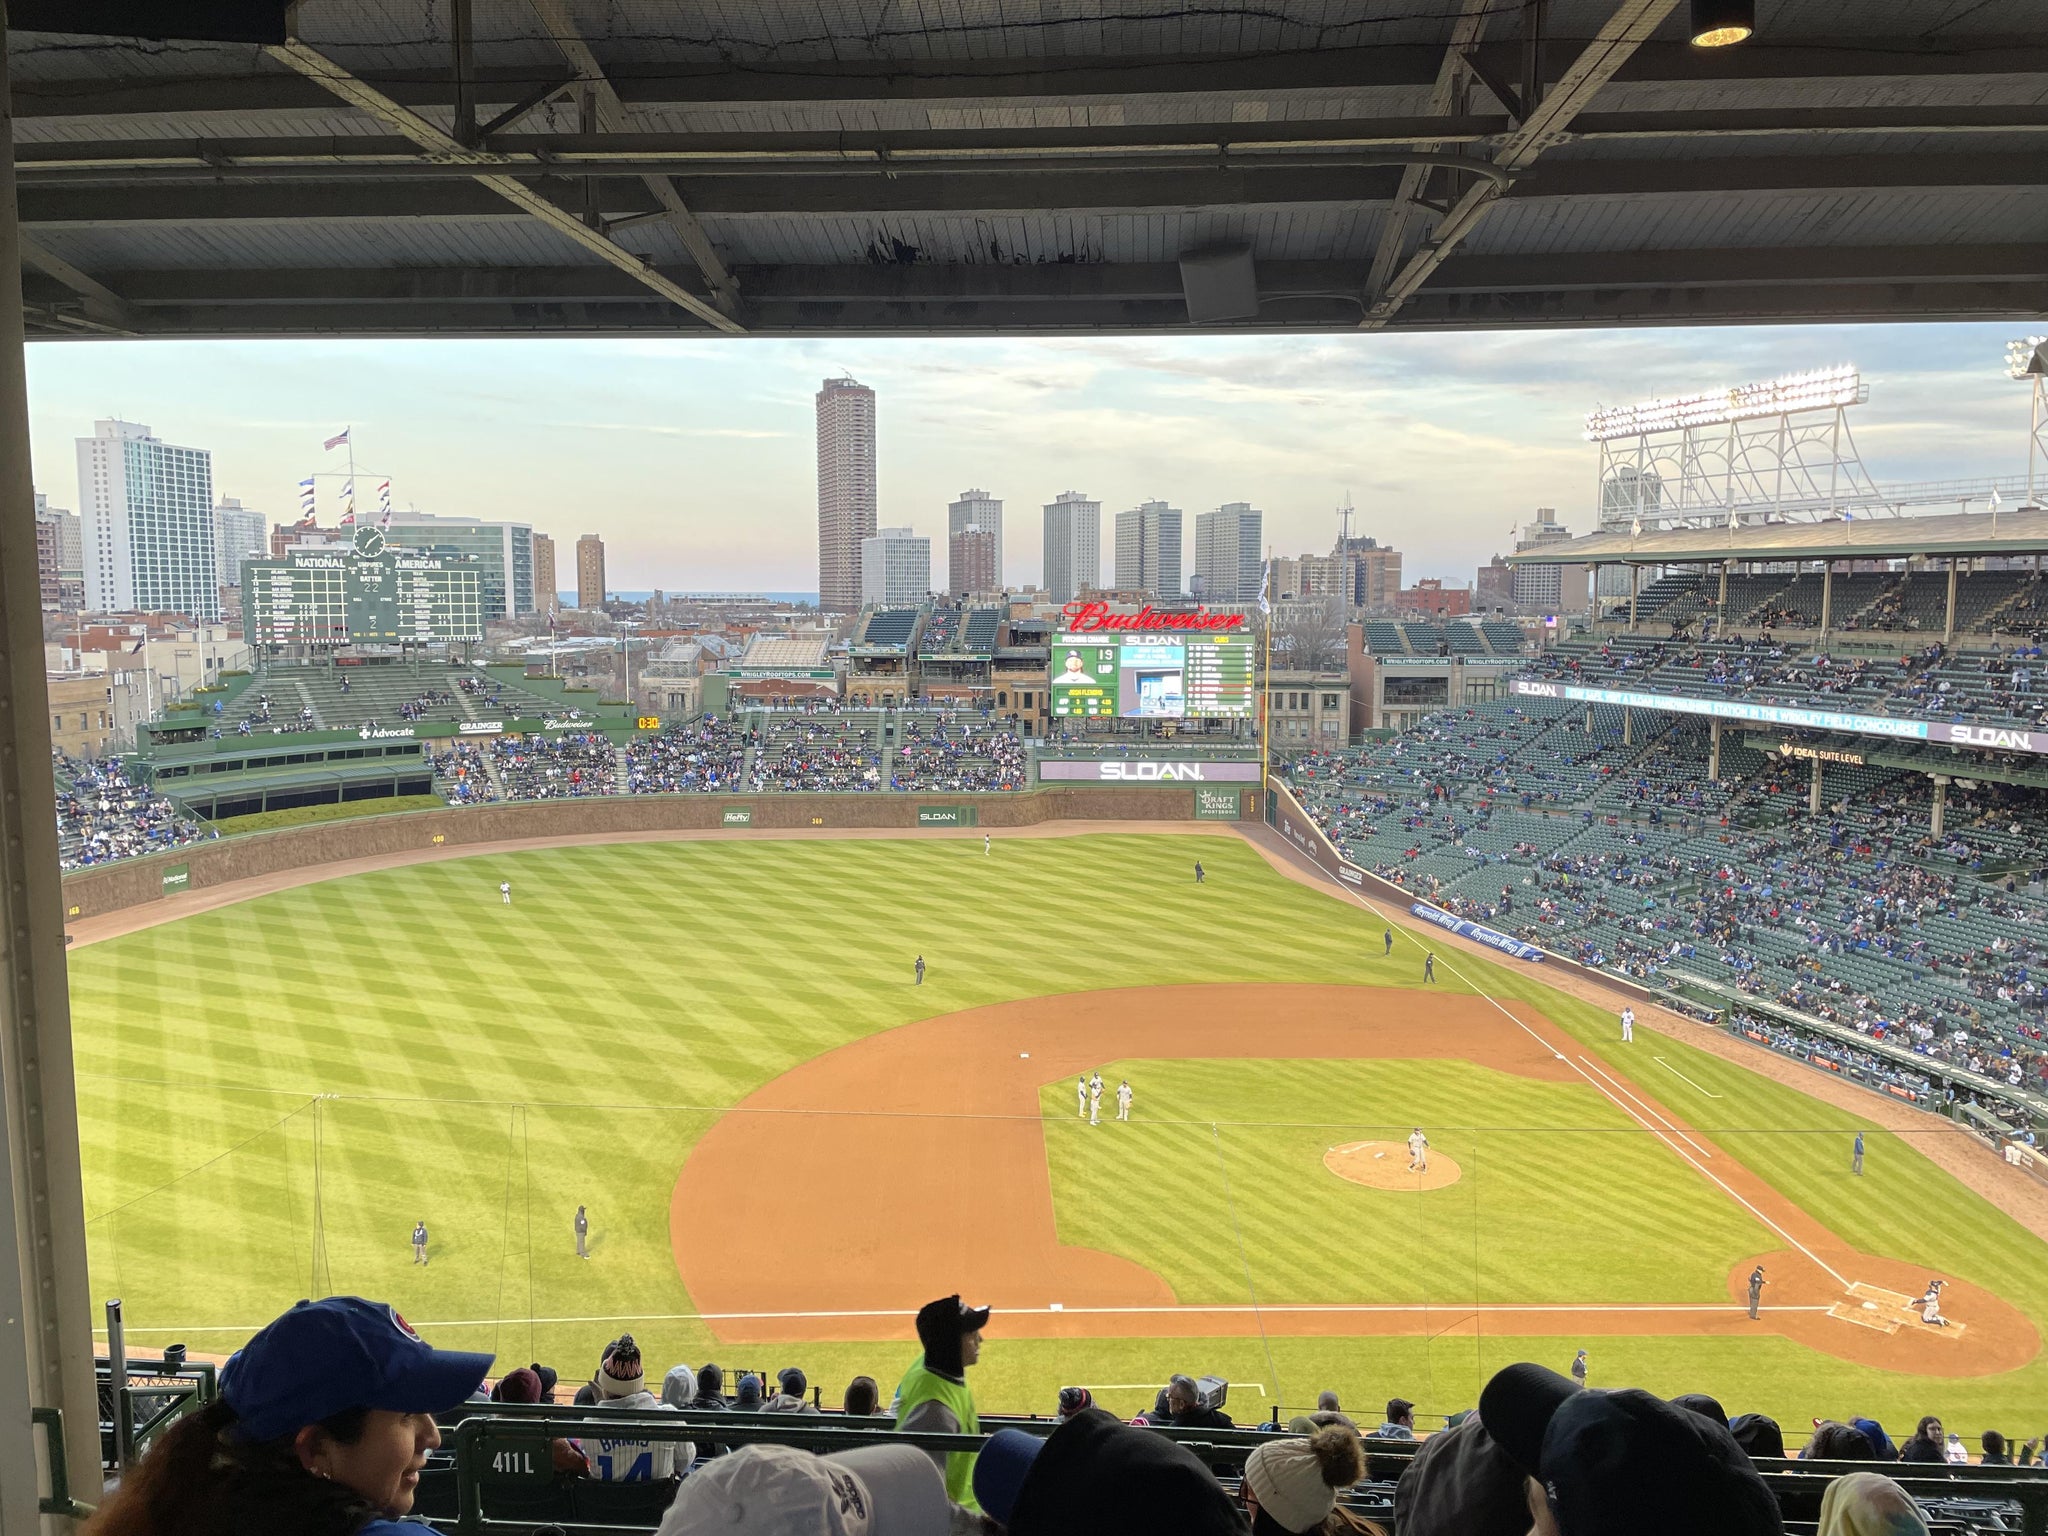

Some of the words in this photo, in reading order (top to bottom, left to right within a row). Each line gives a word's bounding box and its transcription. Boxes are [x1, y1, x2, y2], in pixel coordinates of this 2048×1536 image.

[295, 558, 346, 568] NATIONAL
[395, 560, 442, 569] AMERICAN
[1062, 600, 1245, 633] Budweiser
[370, 620, 377, 629] 2
[1100, 649, 1113, 660] 19
[459, 721, 503, 731] GRAINGER
[543, 719, 594, 730] Budweiser
[1714, 702, 1747, 717] STATION
[1761, 708, 1777, 721] THE
[1779, 711, 1823, 726] WRIGLEY
[1824, 716, 1852, 729] FIELD
[1853, 718, 1920, 737] CONCOURSE
[372, 728, 415, 738] Advocate
[1794, 747, 1818, 759] IDEAL
[1819, 750, 1840, 762] SUITE
[1840, 753, 1864, 765] LEVEL
[1202, 796, 1234, 804] DRAFT
[726, 813, 748, 822] Hefty
[1338, 865, 1362, 881] GRAINGER
[1414, 906, 1441, 924] Reynolds
[1438, 915, 1455, 929] Wrap
[1470, 928, 1500, 946] Reynolds
[1499, 938, 1518, 955] Wrap
[492, 1451, 520, 1474] 411
[524, 1452, 534, 1474] L
[597, 1452, 653, 1482] 14
[842, 1474, 866, 1520] adidas
